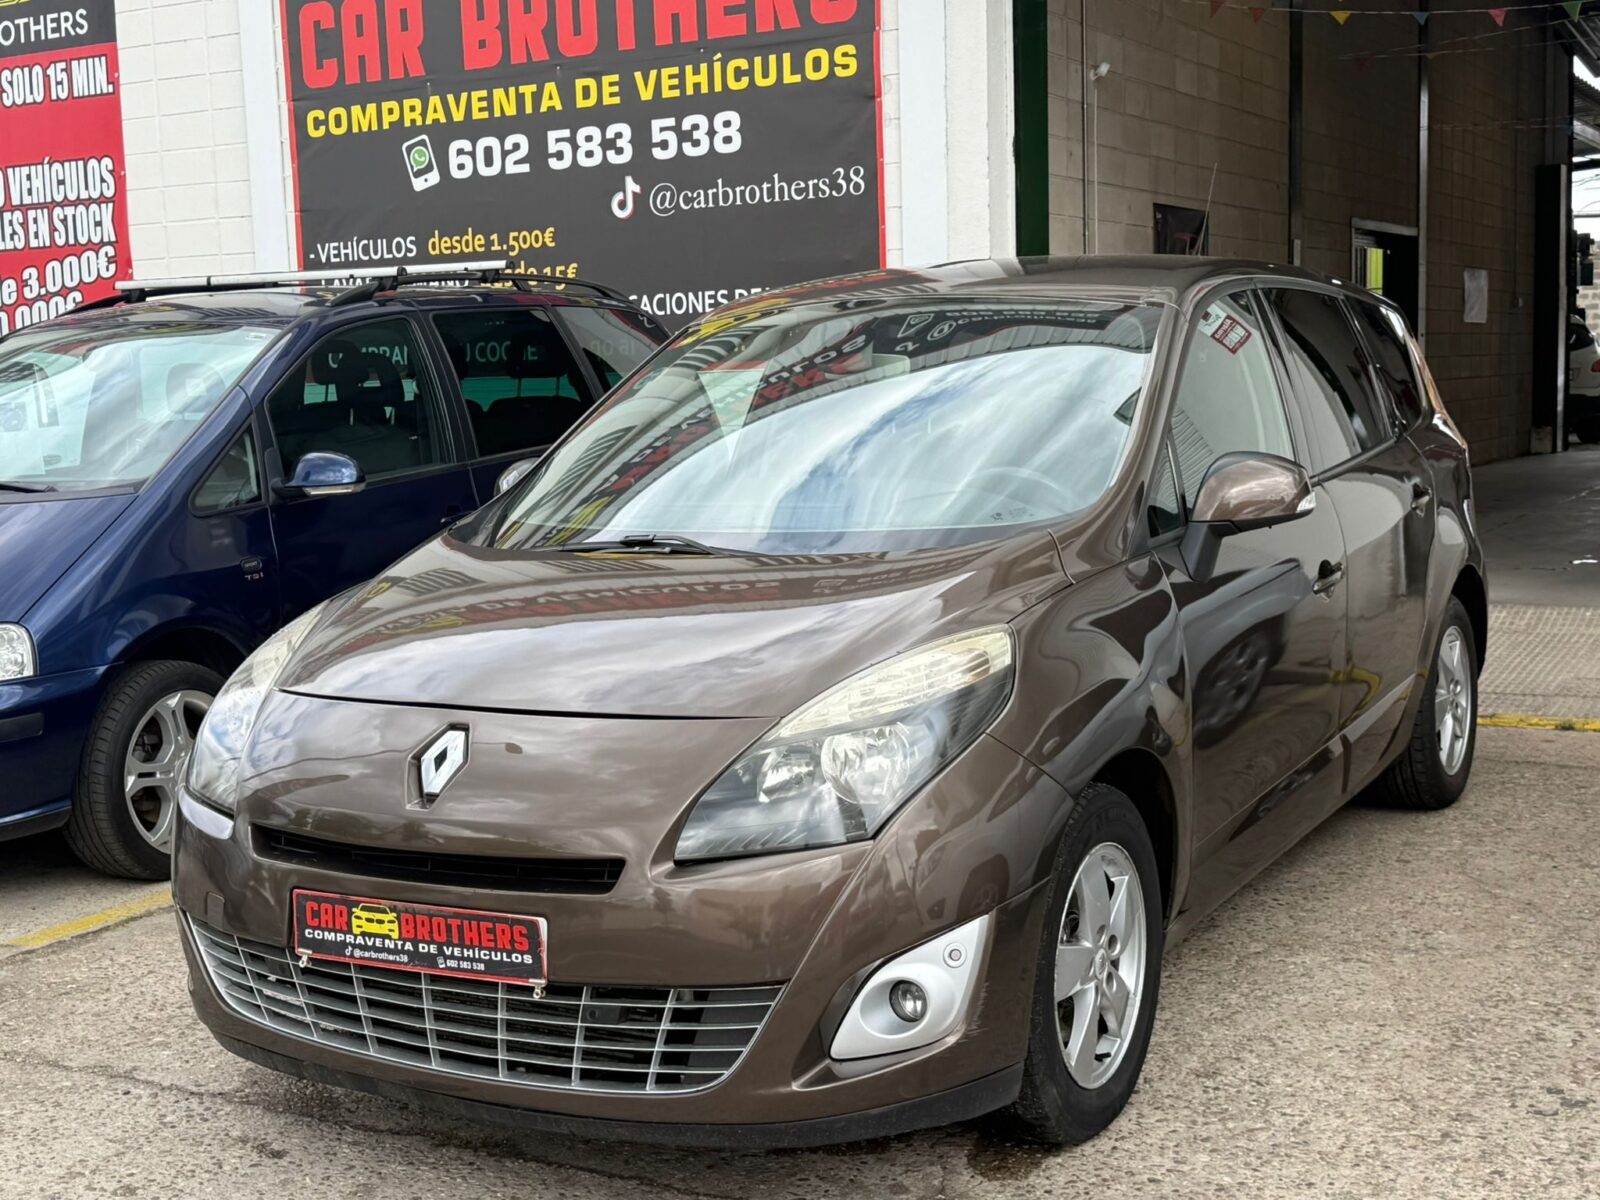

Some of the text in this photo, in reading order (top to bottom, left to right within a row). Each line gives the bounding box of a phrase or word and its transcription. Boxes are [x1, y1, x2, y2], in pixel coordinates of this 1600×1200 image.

[299, 0, 426, 89] CAR
[0, 55, 114, 107] SOLO 15 MIN.
[306, 44, 858, 138] COMPRAVENTA DE VEHÍCULOS
[447, 110, 742, 180] 602 583 538
[6, 156, 116, 206] VEHÍCULOS
[649, 165, 866, 217] @carbrothers38
[27, 207, 51, 248] EN
[53, 202, 117, 247] STOCK
[428, 228, 486, 256] desde
[490, 227, 556, 257] 1.500€
[22, 245, 117, 299] 3.000€
[629, 289, 729, 316] ACIONES
[304, 929, 533, 964] COMPRAVENTA DE VEHÍCULOS
[305, 901, 530, 951] CAR BROTHERS
